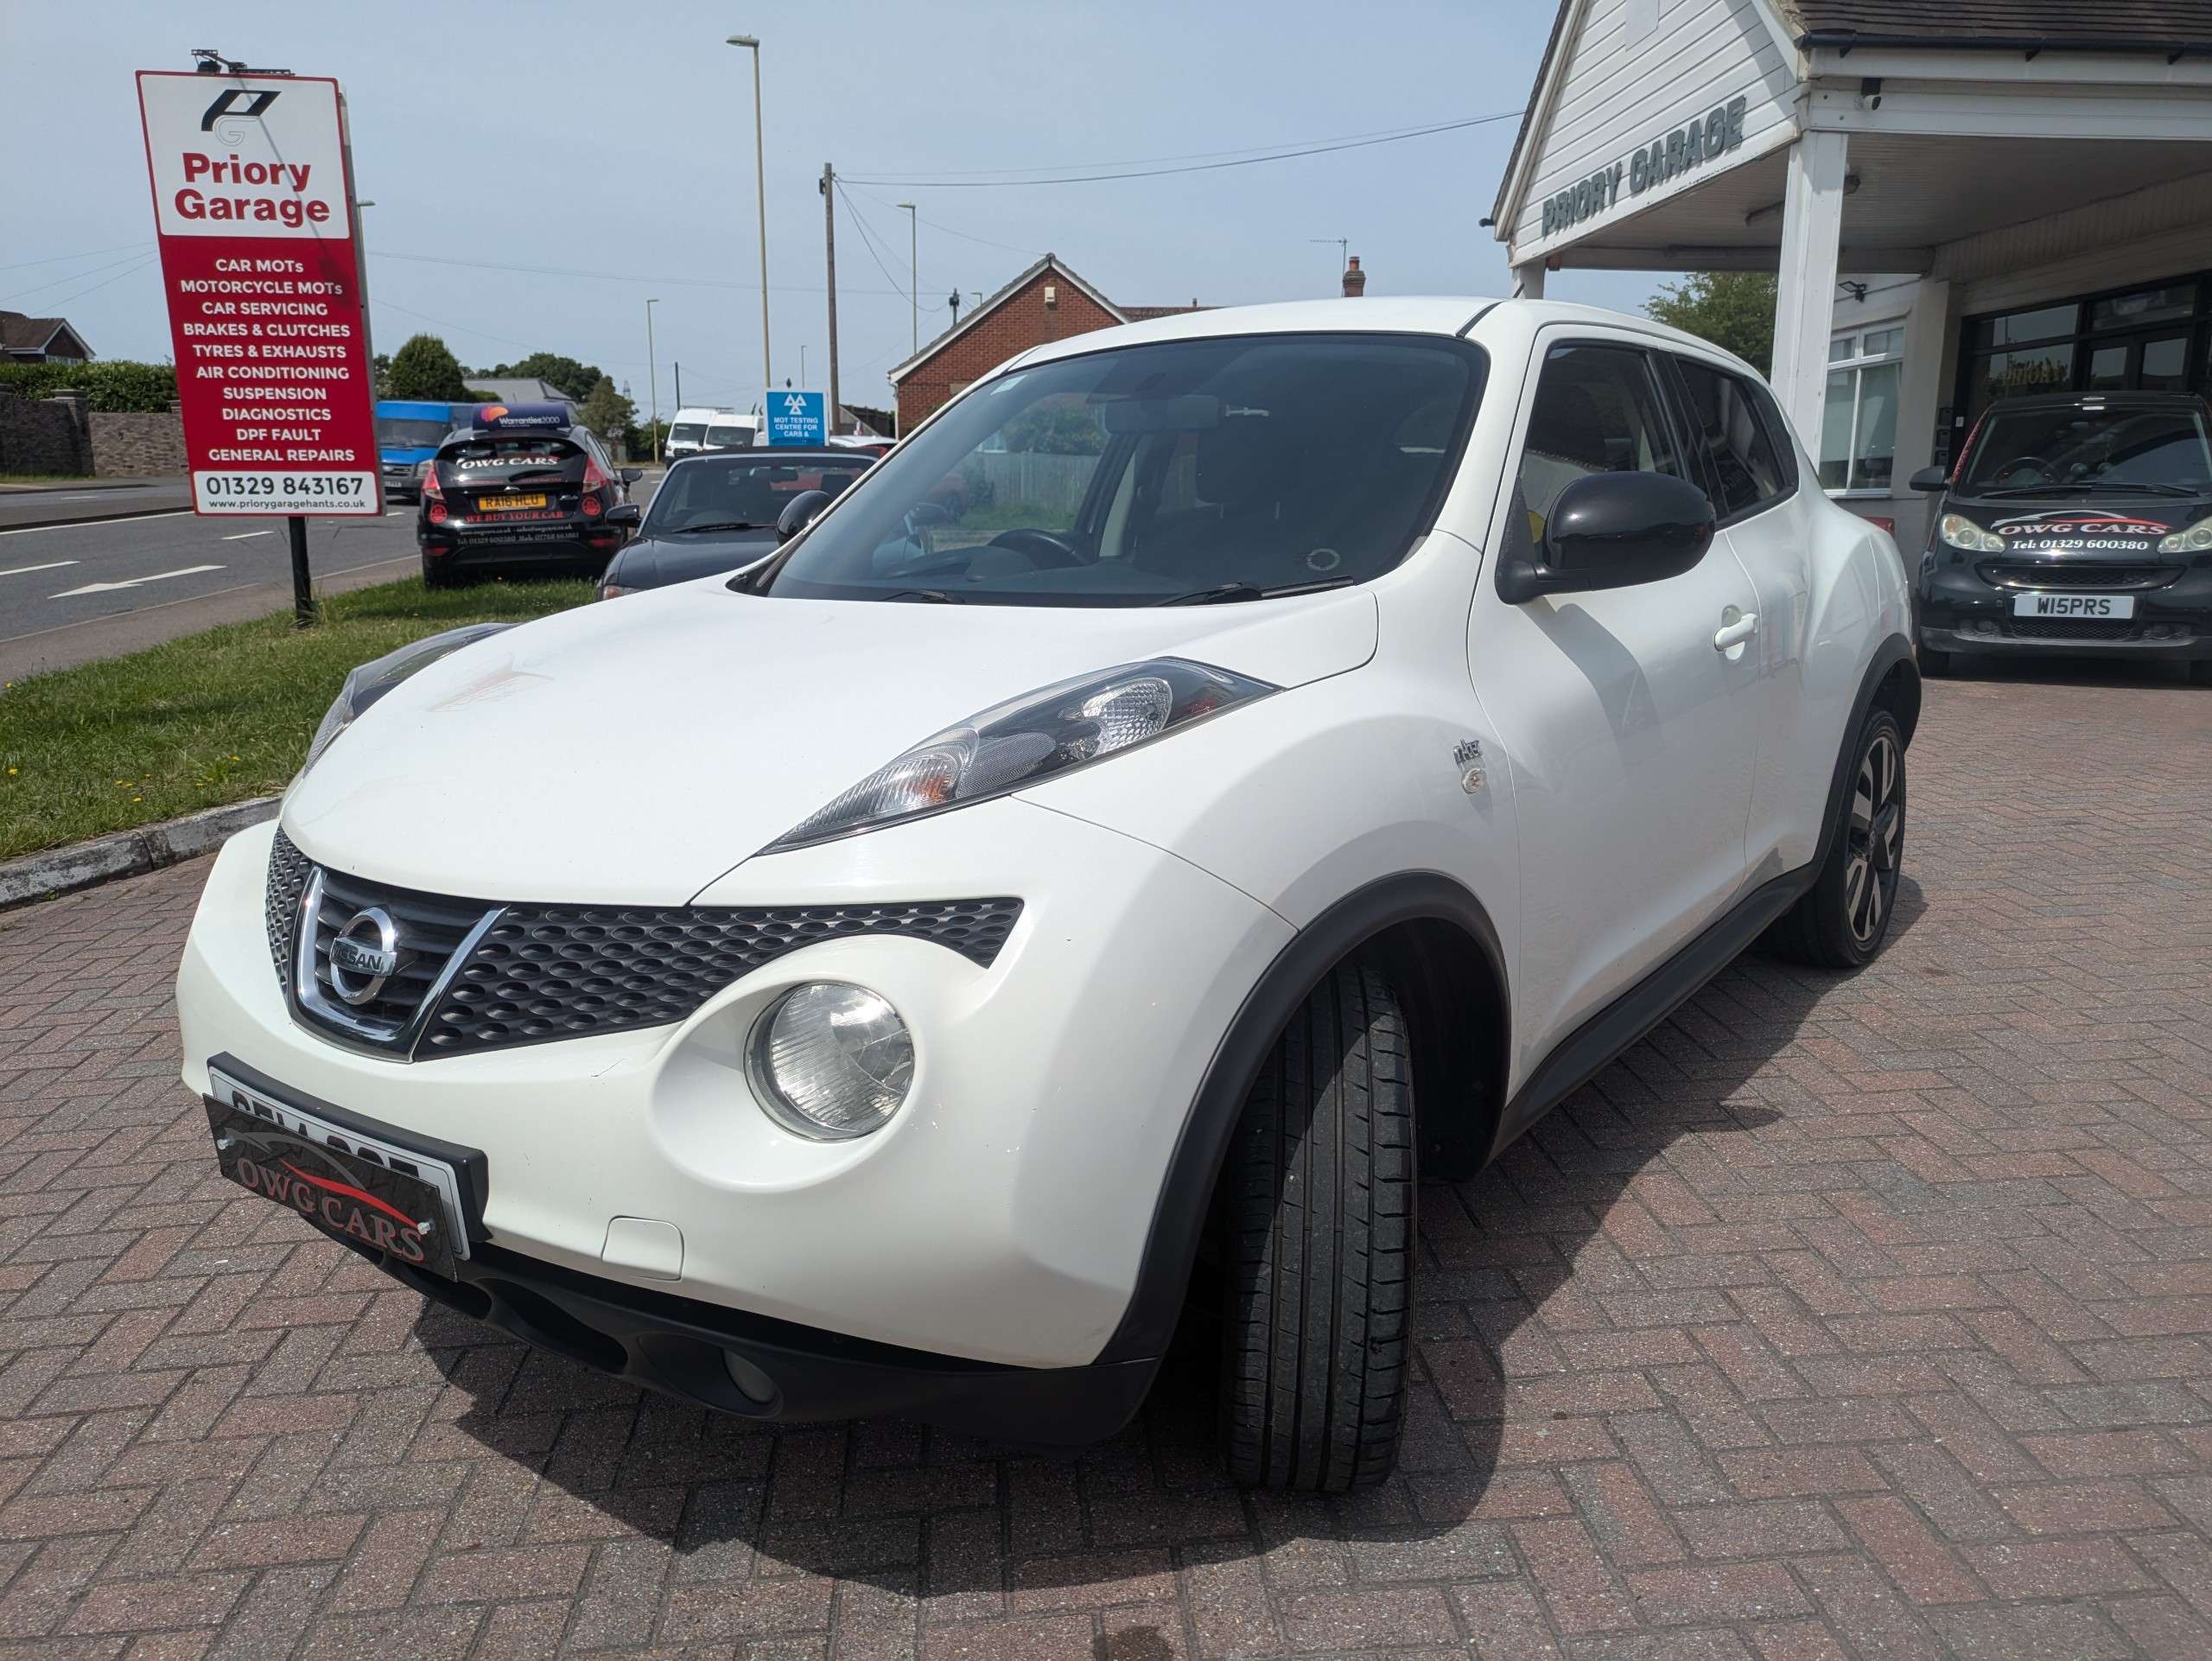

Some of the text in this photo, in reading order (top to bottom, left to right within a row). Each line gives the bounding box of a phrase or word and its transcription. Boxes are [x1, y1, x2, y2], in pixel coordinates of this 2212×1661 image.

[182, 152, 311, 192] Priory
[1541, 94, 1746, 238] PRIORY GARAGE
[175, 188, 330, 228] Garage
[216, 259, 304, 273] CAR MOTs
[181, 280, 343, 296] MOTORCYCLE MOTs
[202, 302, 327, 316] CAR SERVICING
[183, 323, 351, 337] BRAKES & CLUTCHES
[193, 344, 346, 359] TYRES & EXHAUSTS
[196, 366, 349, 379] AIR CONDITIONING
[223, 387, 327, 400] SUSPENSION
[222, 408, 332, 421] DIAGNOSTICS
[236, 429, 321, 442] DPF FAULT
[208, 449, 355, 461] GENERAL REPAIRS
[461, 457, 559, 469] OWG CARS
[206, 477, 364, 495] 01329 843167
[209, 499, 365, 510] www.priorygaragehants.co.uk
[466, 511, 564, 523] WE BUY YOUR CAR
[1998, 523, 2168, 536] OWG CARS
[2012, 539, 2149, 550] Tel: 01329 600380
[237, 1156, 426, 1264] OWG CARS
